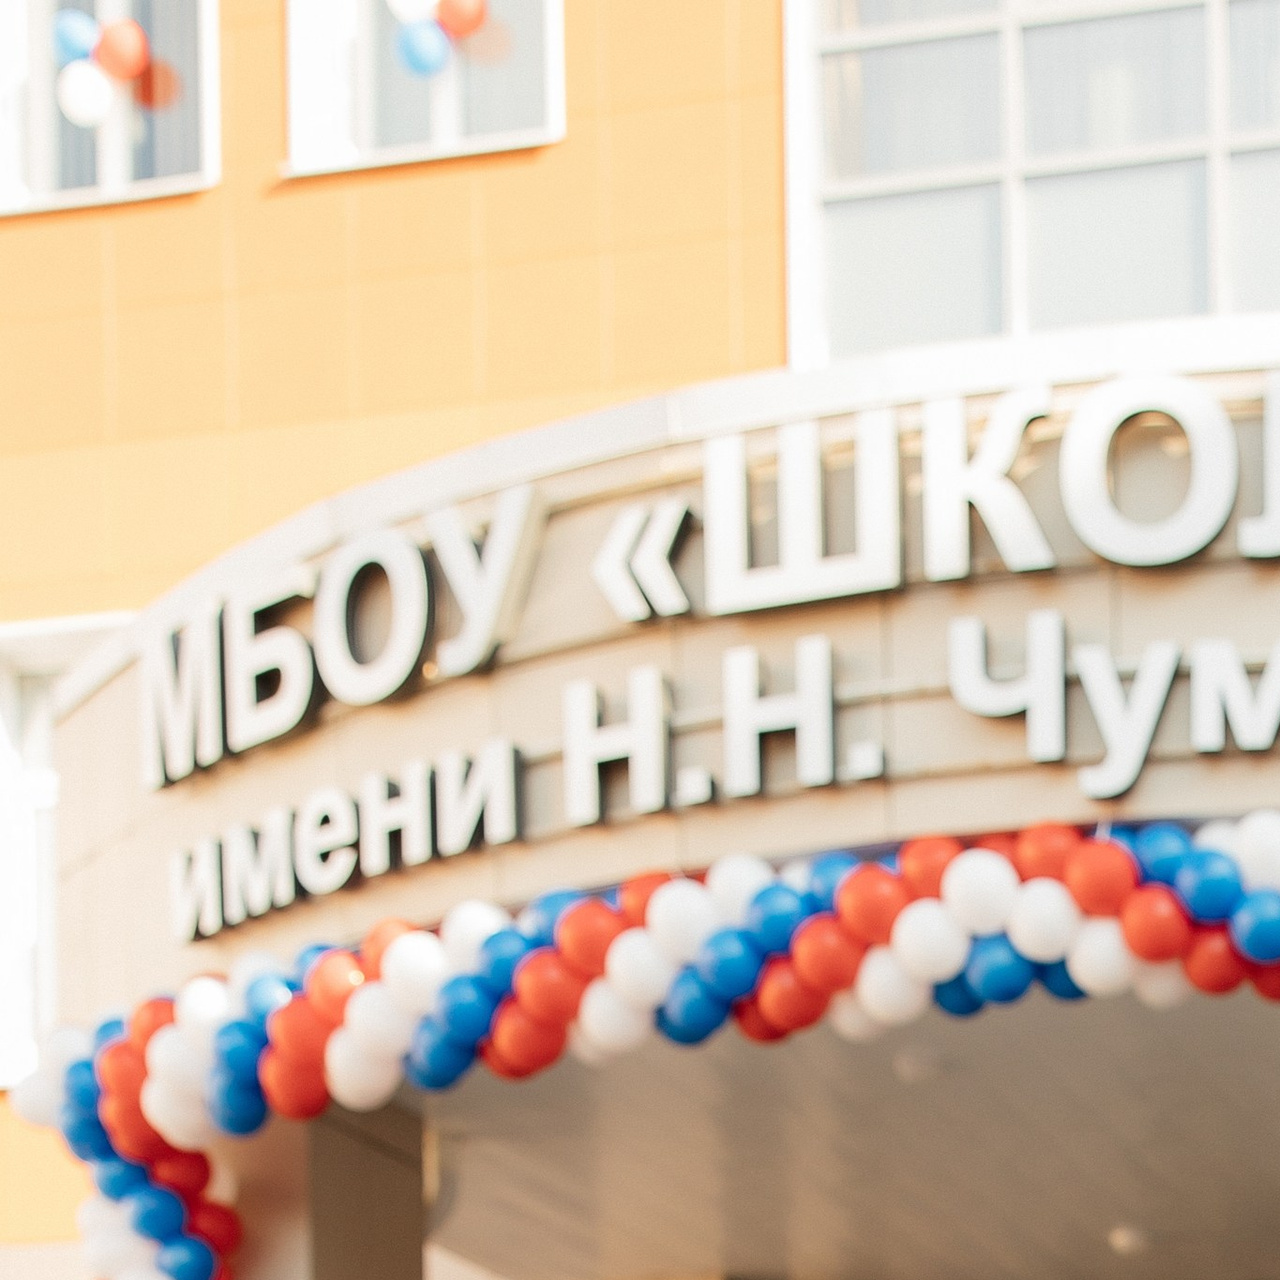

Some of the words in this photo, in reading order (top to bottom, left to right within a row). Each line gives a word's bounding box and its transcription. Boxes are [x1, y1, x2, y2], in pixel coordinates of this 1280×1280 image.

[141, 483, 543, 793] МБОУ
[171, 738, 520, 943] имени
[562, 635, 884, 825] Н.Н.
